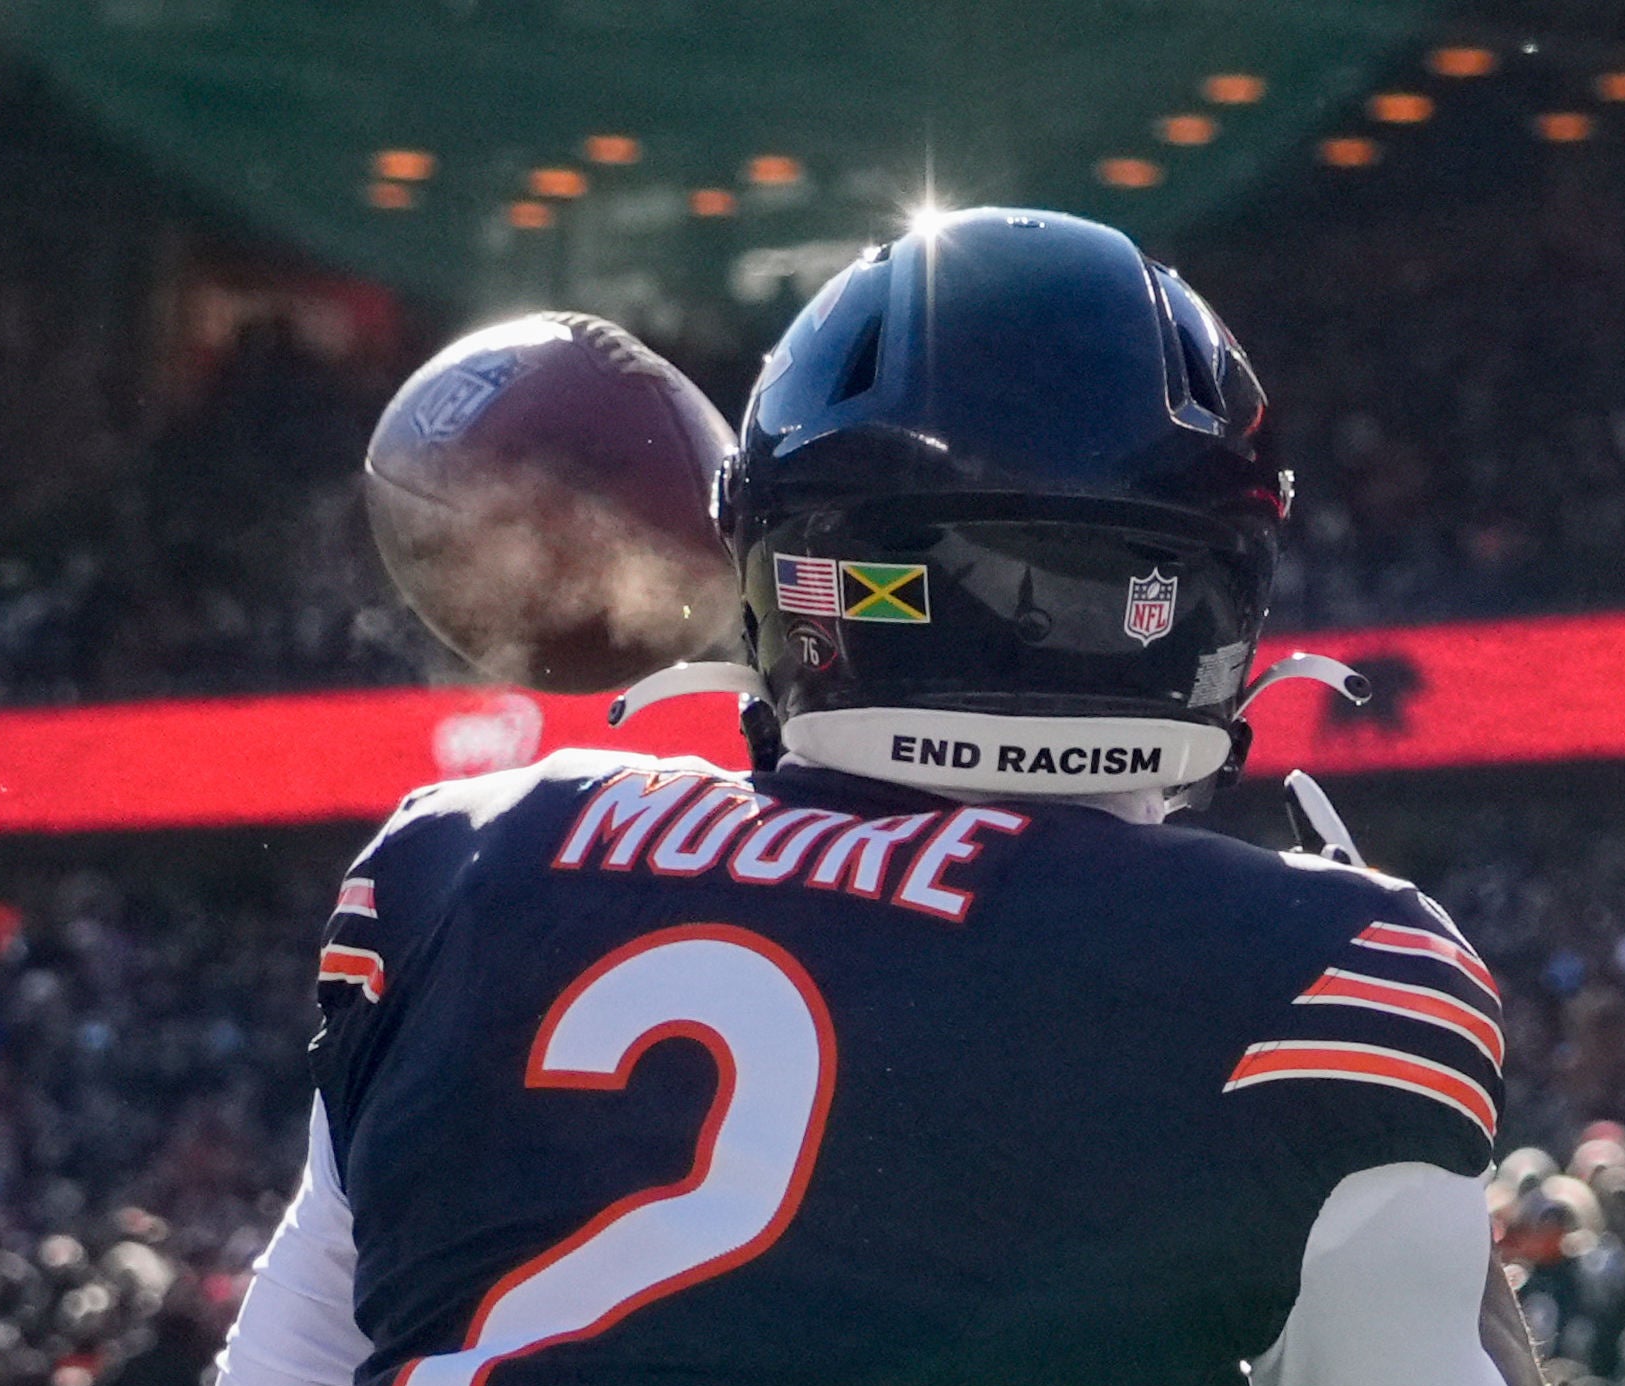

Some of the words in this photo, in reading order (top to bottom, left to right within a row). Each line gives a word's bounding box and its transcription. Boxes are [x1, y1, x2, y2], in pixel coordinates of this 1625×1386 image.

[1133, 603, 1166, 632] NFL
[800, 636, 820, 666] 76
[891, 734, 981, 769] END
[997, 745, 1162, 775] RACISM
[550, 768, 1033, 923] MOORE
